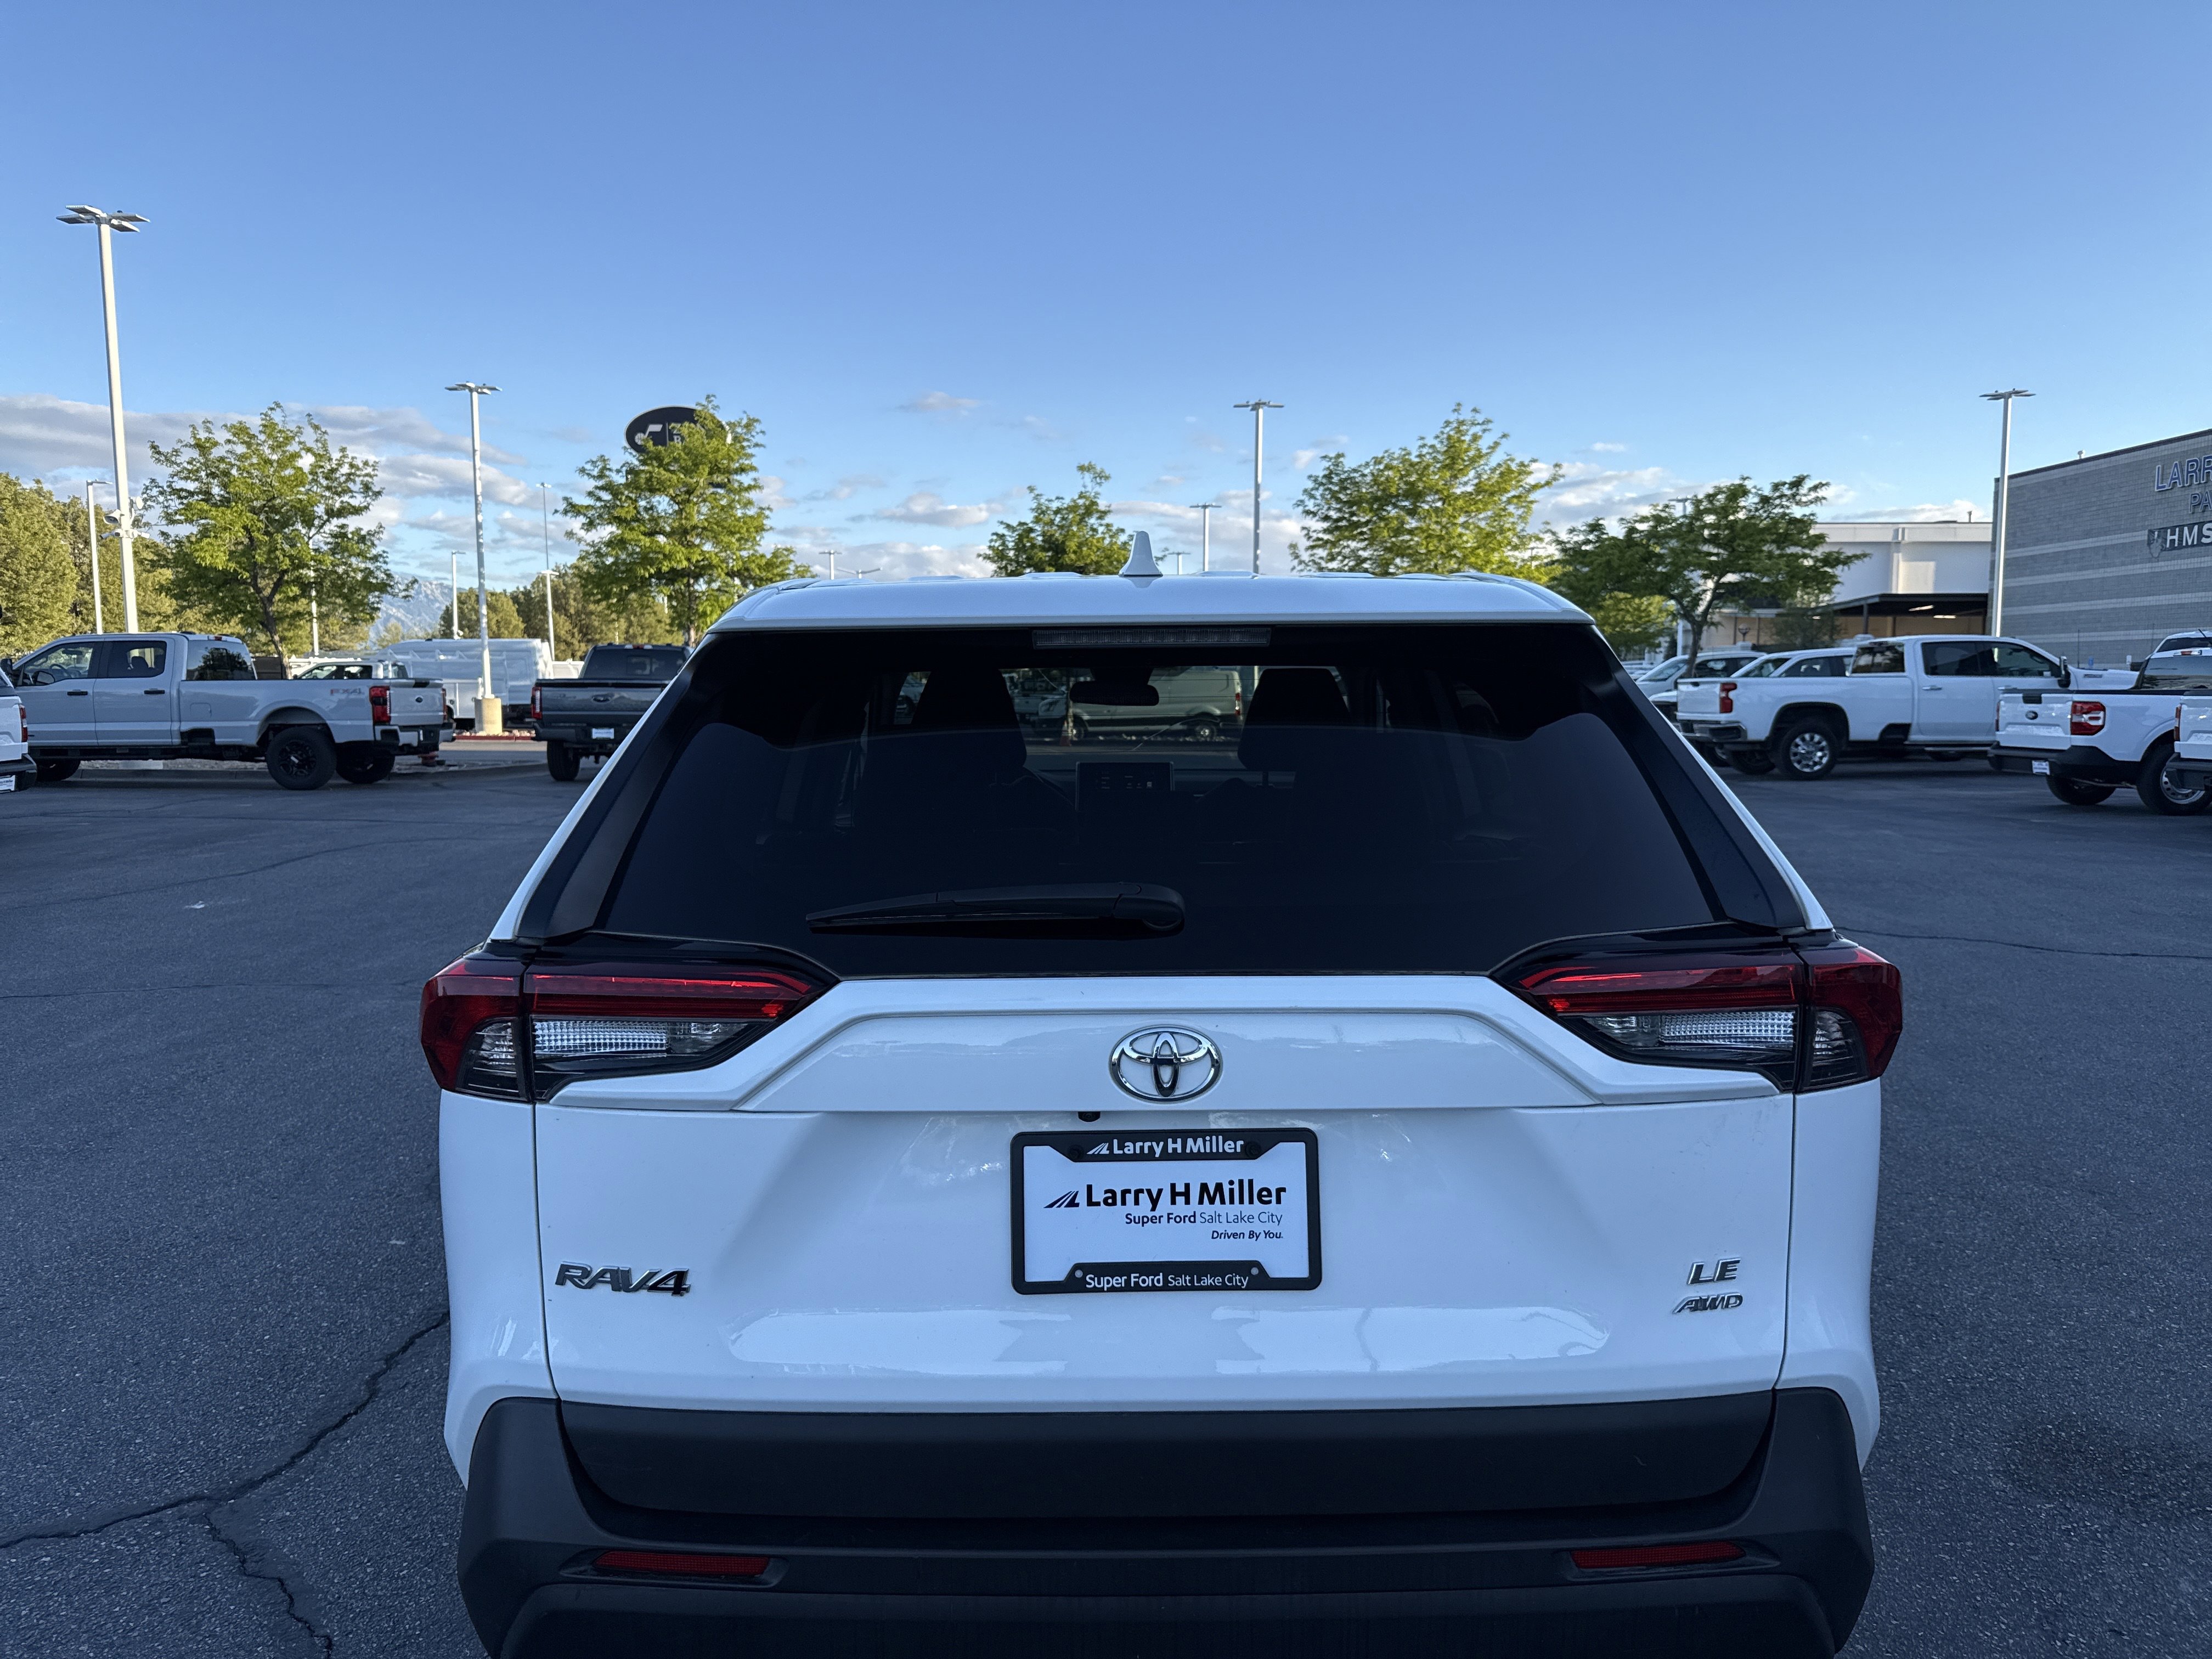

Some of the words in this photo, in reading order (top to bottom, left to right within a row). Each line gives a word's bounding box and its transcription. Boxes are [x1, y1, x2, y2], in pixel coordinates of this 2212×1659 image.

[2154, 454, 2212, 492] LARR
[1113, 1139, 1164, 1158] Larry
[1167, 1138, 1182, 1153] H
[1186, 1135, 1244, 1153] Miller
[1086, 1184, 1164, 1212] Larry
[1170, 1182, 1190, 1205] H
[1198, 1178, 1286, 1205] Miller
[1125, 1213, 1164, 1227] Super
[1167, 1211, 1197, 1224] Ford
[1199, 1210, 1222, 1223] Salt
[1226, 1210, 1255, 1223] Lake
[1258, 1211, 1283, 1226] City
[1211, 1229, 1245, 1239] Driven
[1248, 1230, 1261, 1242] By
[555, 1261, 691, 1296] RAV4
[1086, 1274, 1127, 1291] Super
[1131, 1272, 1163, 1286] Ford
[1168, 1274, 1191, 1286] Salt
[1194, 1274, 1222, 1286] Lake
[1224, 1273, 1249, 1288] City
[1686, 1257, 1741, 1285] LE
[1672, 1291, 1743, 1314] AWD
